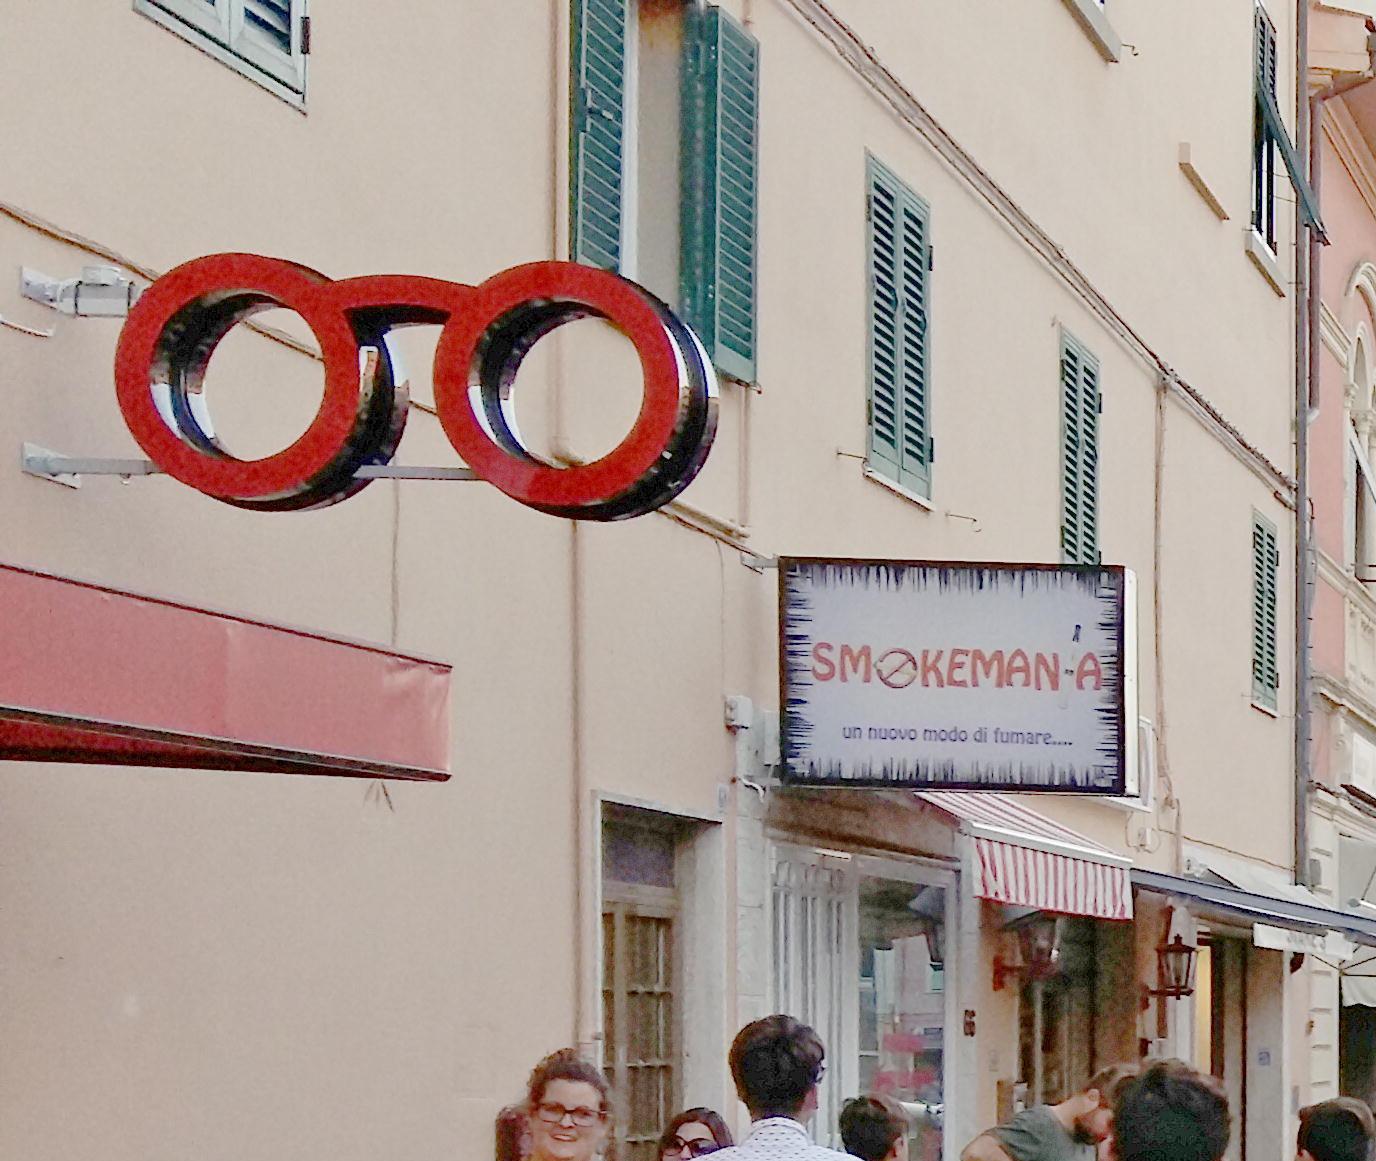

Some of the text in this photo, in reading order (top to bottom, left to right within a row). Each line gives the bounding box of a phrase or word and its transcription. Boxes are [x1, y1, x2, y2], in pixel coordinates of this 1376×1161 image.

[842, 726, 862, 740] un
[868, 727, 917, 741] nuovo
[923, 726, 968, 743] modo
[973, 727, 988, 744] di
